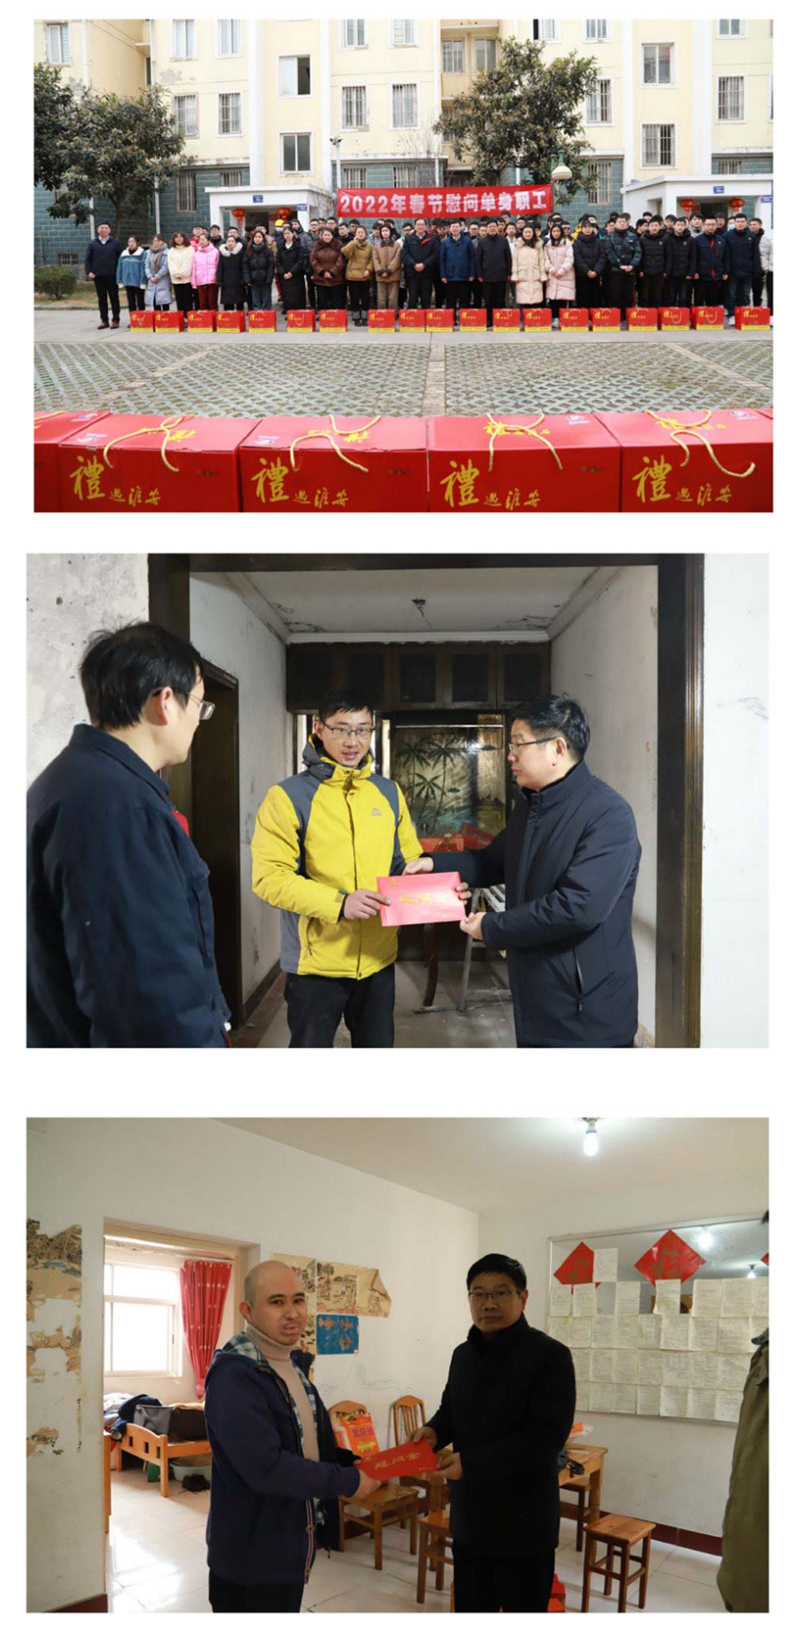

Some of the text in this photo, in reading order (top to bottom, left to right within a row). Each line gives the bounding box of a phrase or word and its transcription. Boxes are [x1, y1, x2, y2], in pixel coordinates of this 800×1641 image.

[340, 191, 547, 215] 2022年春节慰问单身职工
